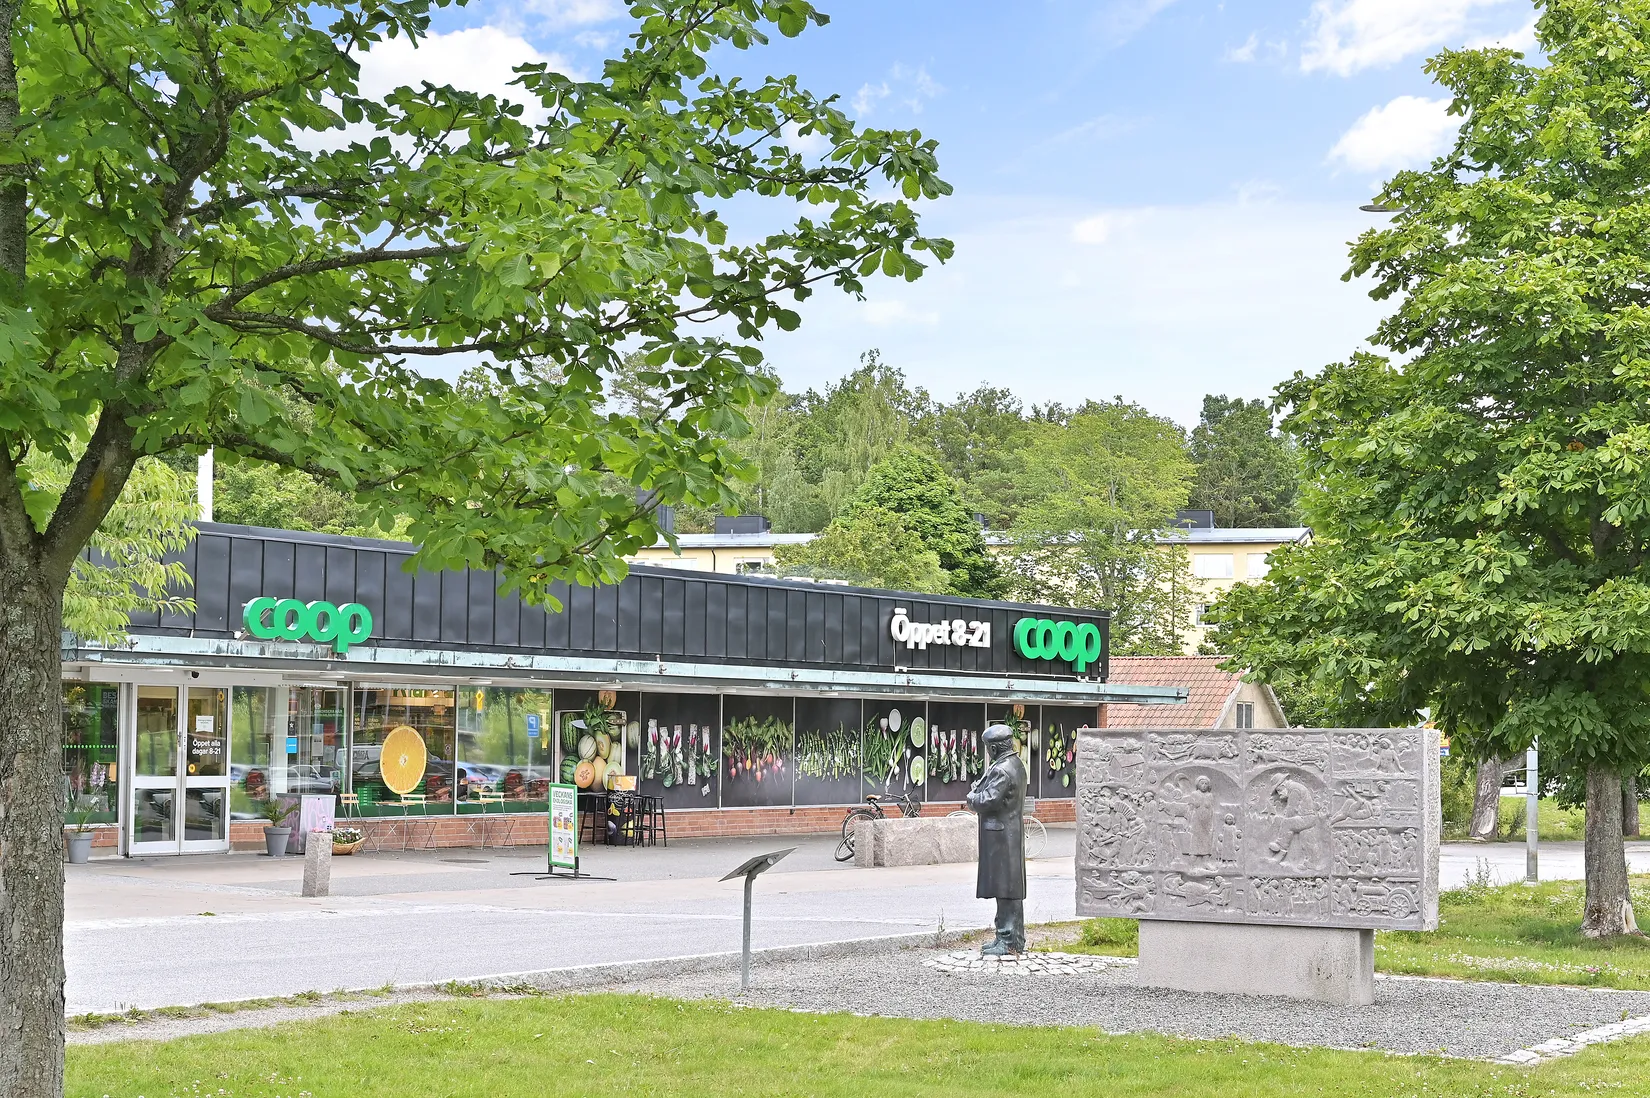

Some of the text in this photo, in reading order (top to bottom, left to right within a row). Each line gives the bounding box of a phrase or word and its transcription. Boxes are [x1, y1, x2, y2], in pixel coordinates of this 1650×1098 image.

[243, 597, 373, 653] coop
[891, 608, 990, 649] Öppet 8-21
[1014, 617, 1101, 672] coop
[192, 738, 210, 748] Öppet
[192, 748, 208, 756] dagar
